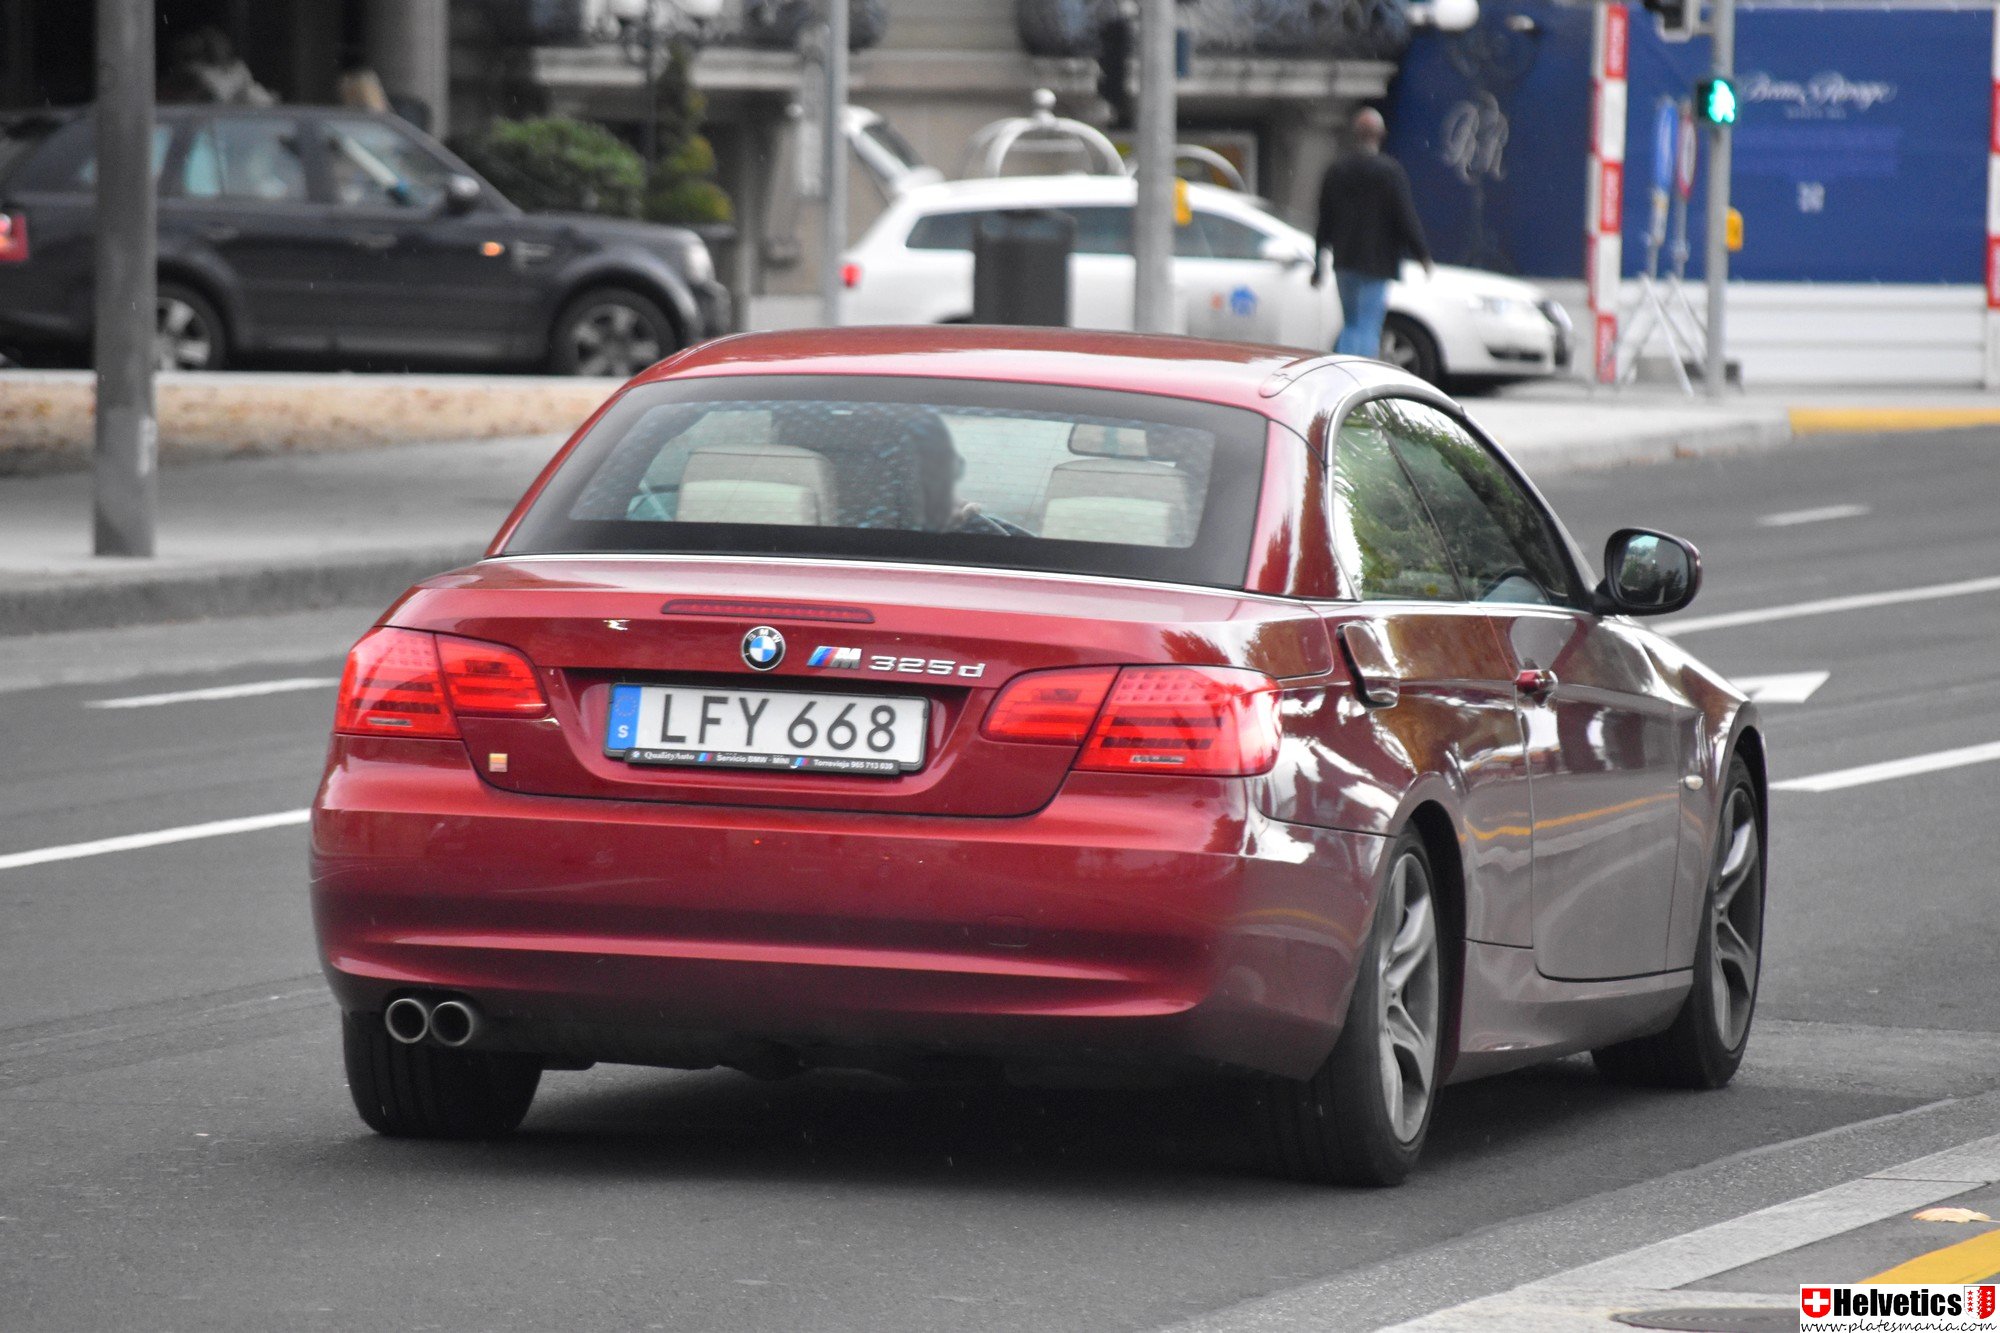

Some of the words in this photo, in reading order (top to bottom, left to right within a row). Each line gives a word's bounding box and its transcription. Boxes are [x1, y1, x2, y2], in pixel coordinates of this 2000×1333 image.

[748, 627, 783, 644] BMW
[829, 647, 863, 670] M
[868, 655, 987, 679] 325d
[660, 693, 770, 747] LFY
[787, 700, 896, 753] 668
[617, 724, 629, 739] S
[643, 750, 695, 761] QualityAuto
[716, 753, 747, 763] Servicio
[747, 755, 768, 764] BMW
